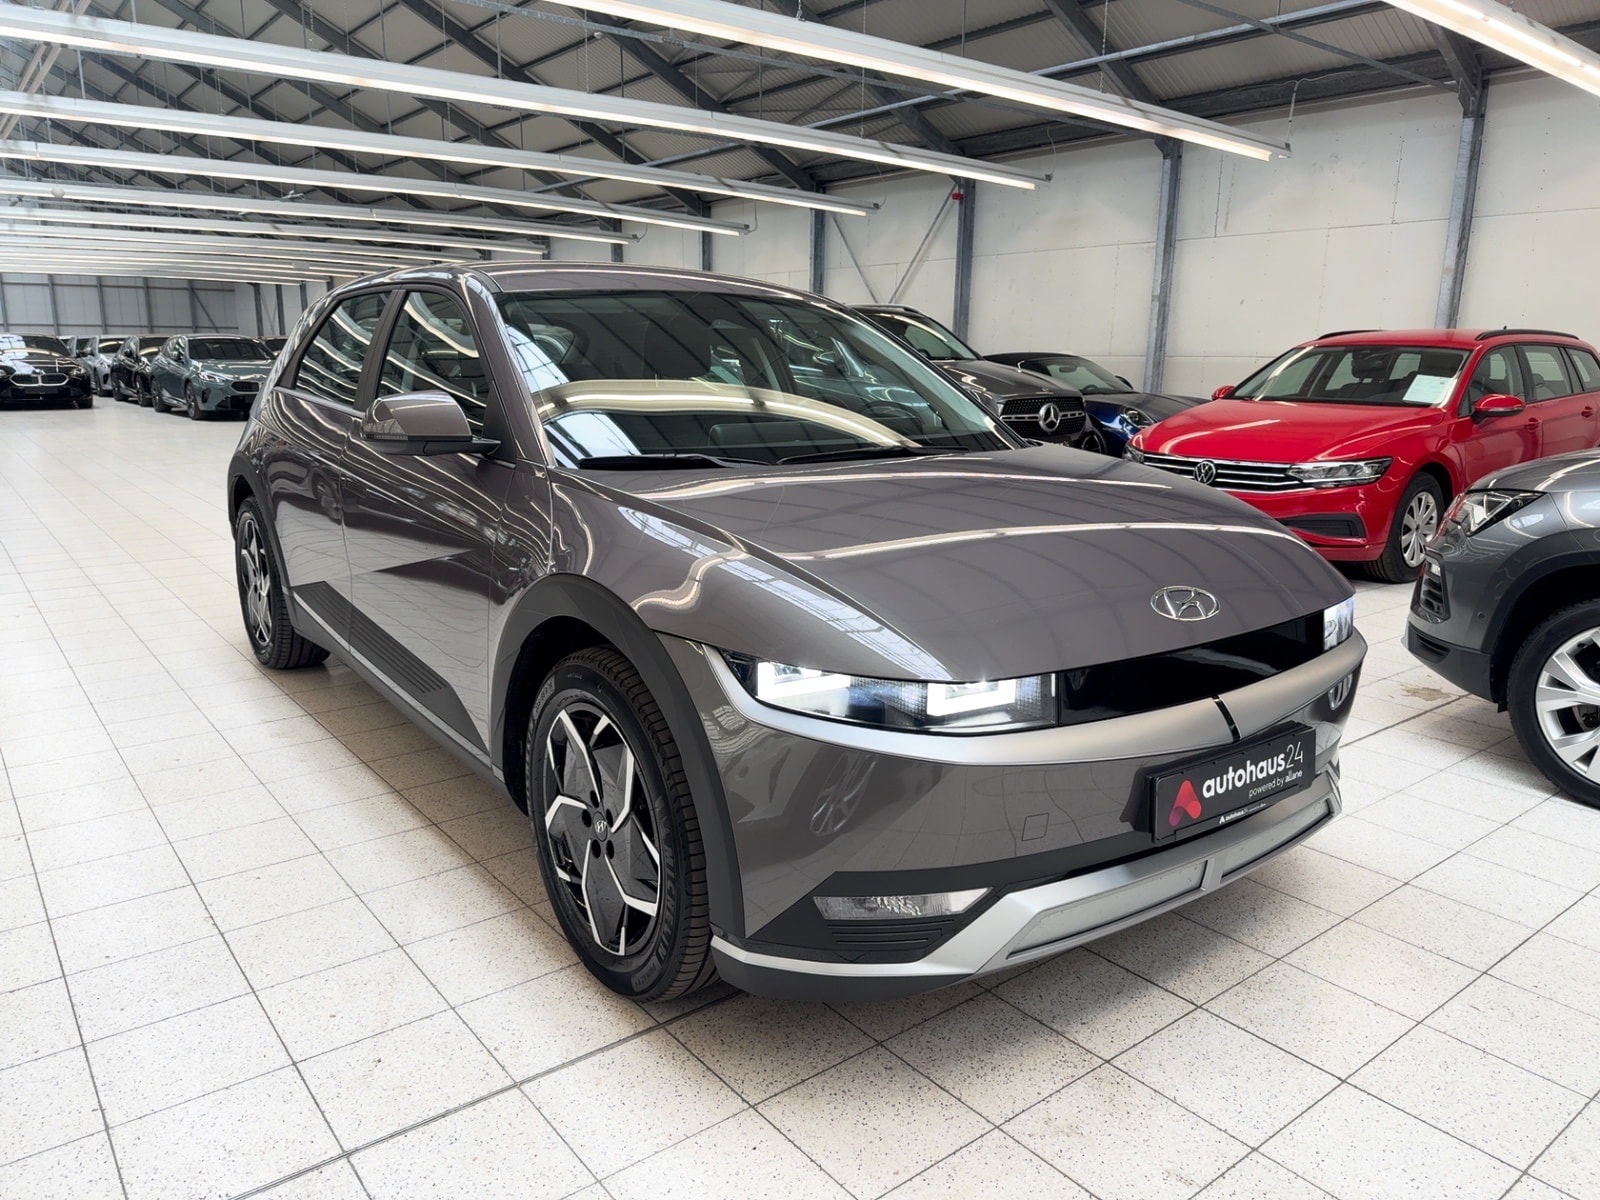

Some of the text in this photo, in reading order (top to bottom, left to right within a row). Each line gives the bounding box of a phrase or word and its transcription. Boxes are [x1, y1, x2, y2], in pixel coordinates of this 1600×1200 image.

[1202, 741, 1303, 798] autohaus24
[1248, 778, 1276, 799] powered
[1276, 776, 1285, 788] by
[656, 844, 676, 964] MICHELIN
